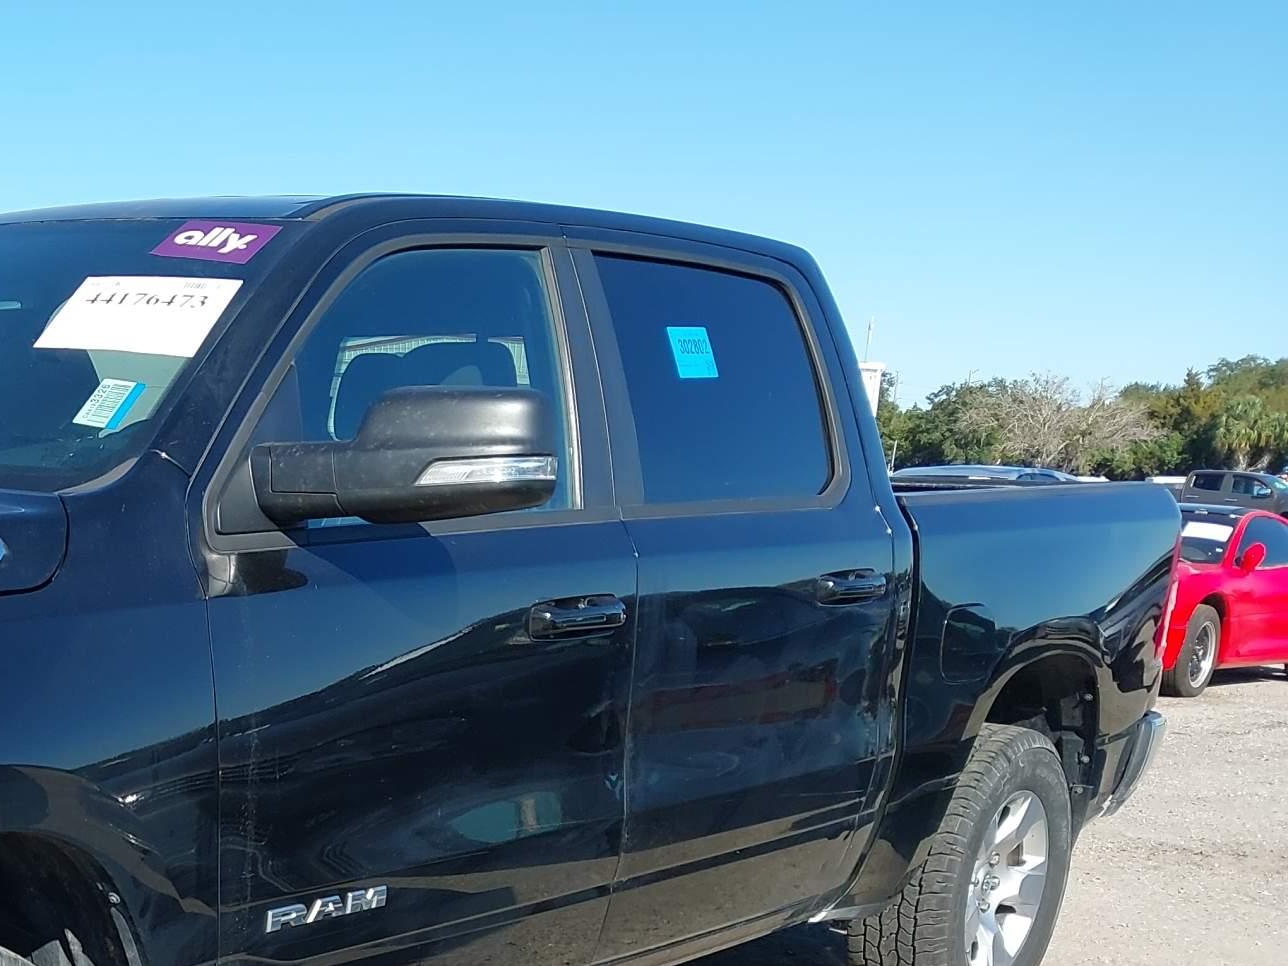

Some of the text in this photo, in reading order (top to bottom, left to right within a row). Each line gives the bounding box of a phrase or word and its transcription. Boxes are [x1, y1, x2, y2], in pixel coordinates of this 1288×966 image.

[85, 292, 208, 308] 44176473
[678, 338, 711, 355] 302802
[265, 885, 387, 933] RAM
